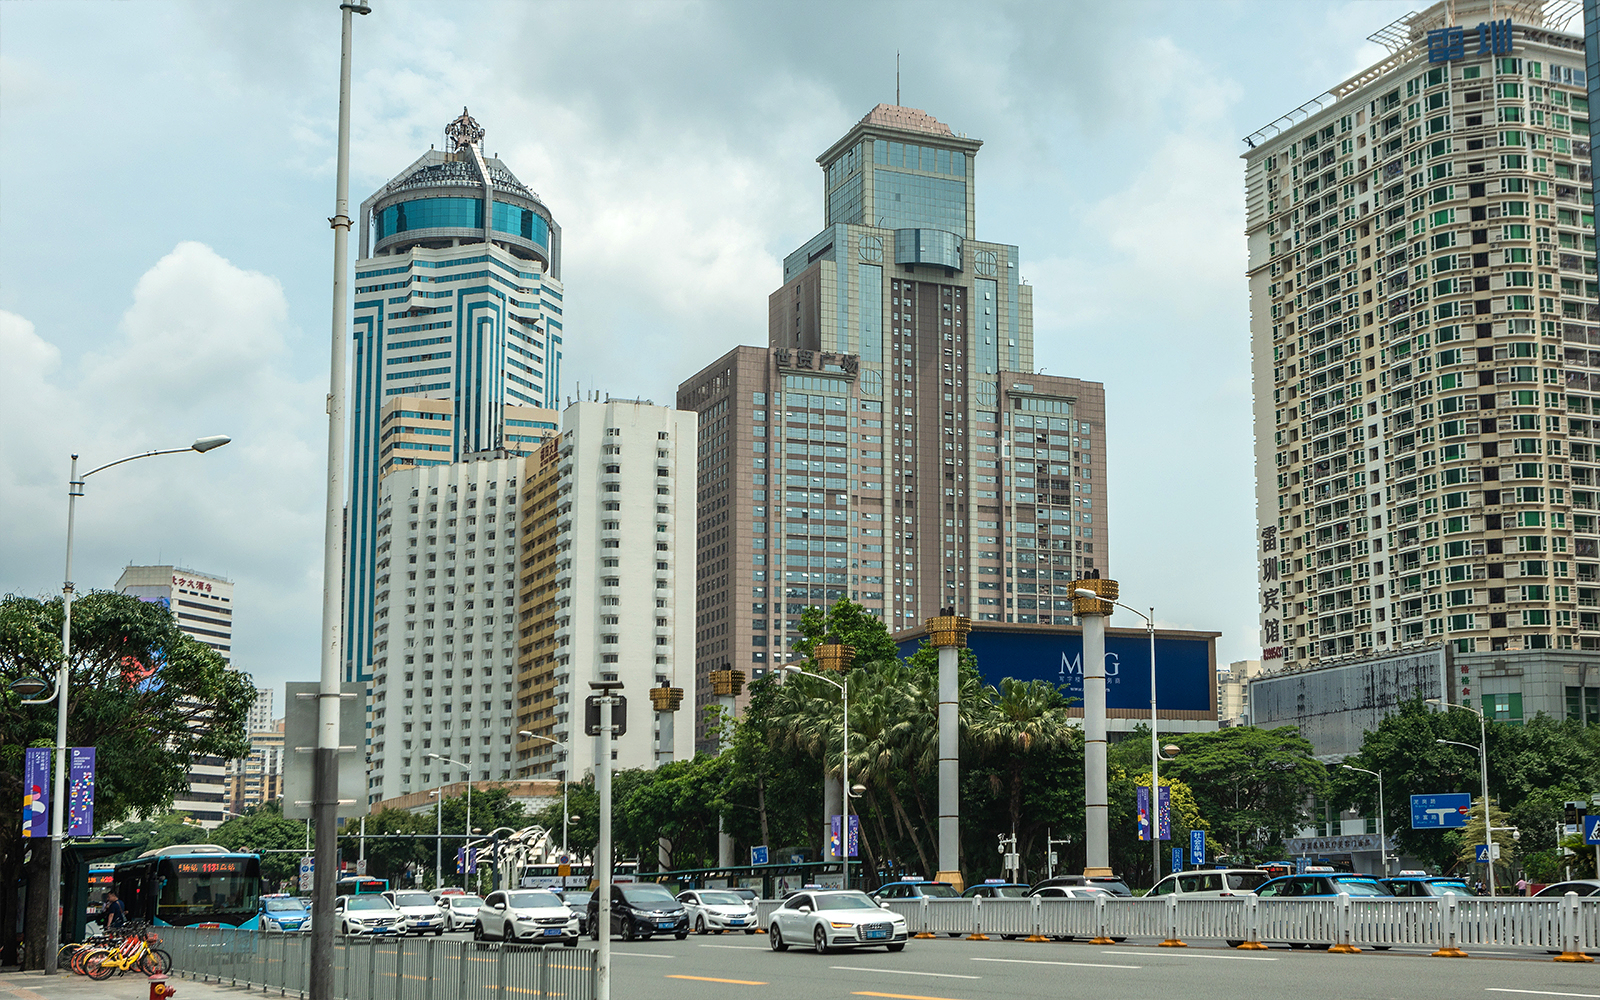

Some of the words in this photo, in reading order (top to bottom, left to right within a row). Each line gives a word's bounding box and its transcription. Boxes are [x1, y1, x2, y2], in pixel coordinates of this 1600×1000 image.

[1427, 18, 1513, 63] 雷圳
[774, 348, 859, 374] 世贸广场
[1261, 525, 1279, 643] 雷圳宾馆
[1059, 651, 1120, 676] MG
